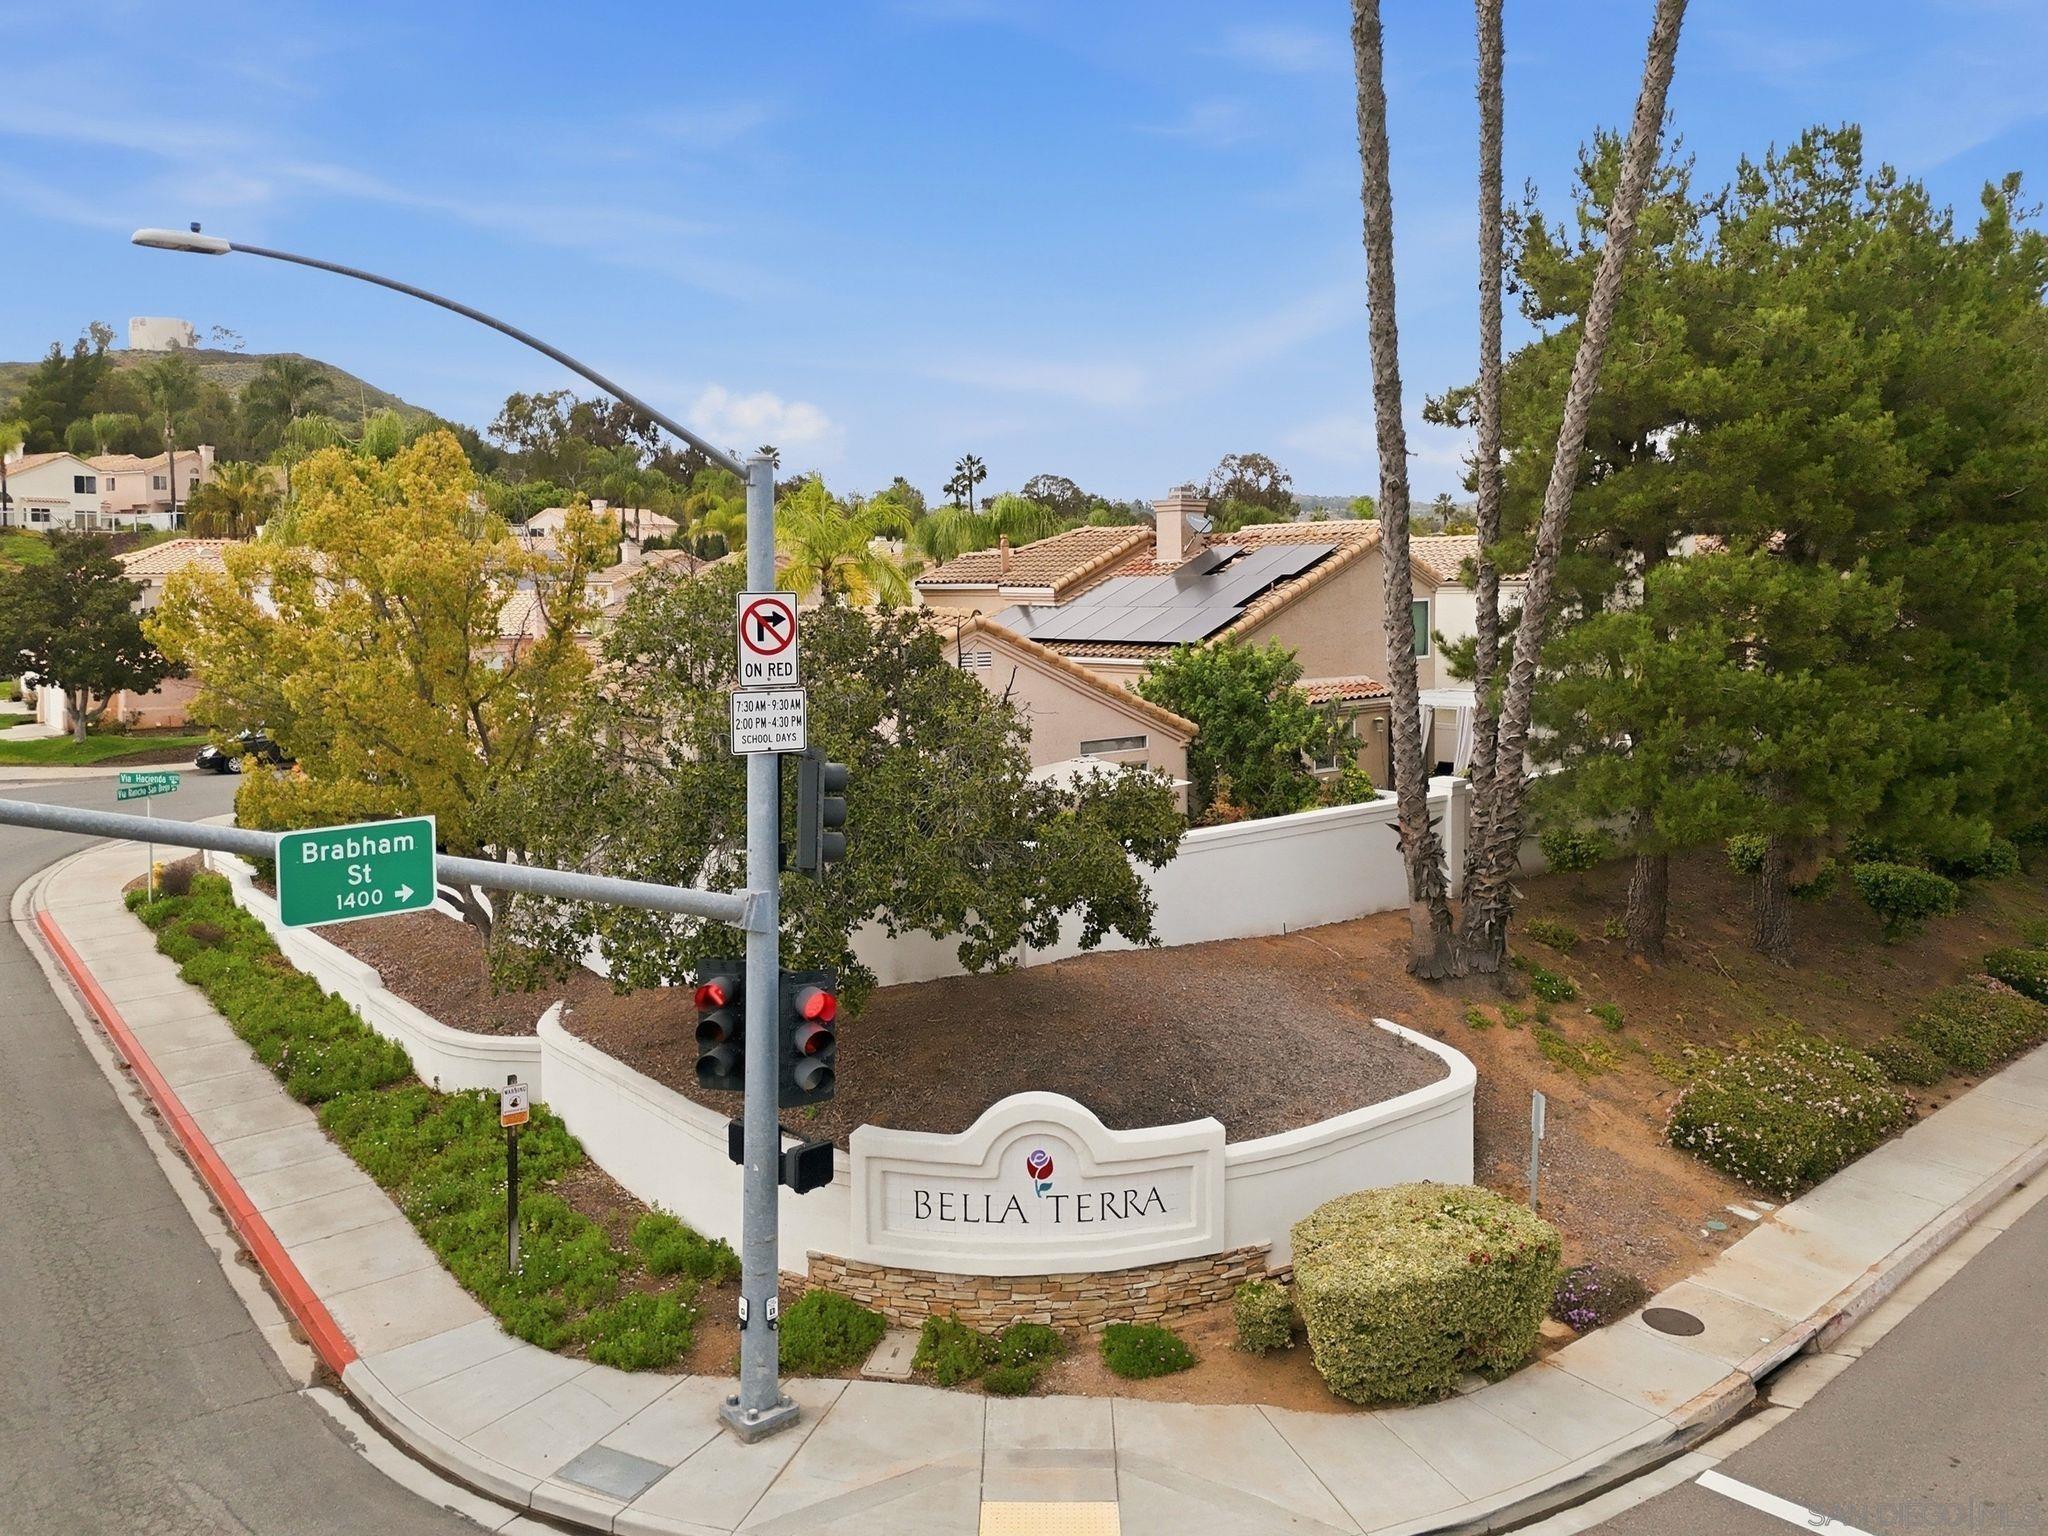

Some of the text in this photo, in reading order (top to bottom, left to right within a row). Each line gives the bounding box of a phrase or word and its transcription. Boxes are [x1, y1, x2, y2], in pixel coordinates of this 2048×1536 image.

[745, 662, 792, 677] ON RED
[736, 700, 754, 713] 7:30
[790, 698, 801, 711] AM
[735, 717, 753, 730] 2:00
[791, 715, 802, 727] PM
[741, 732, 797, 744] SCHOOL DAYS
[121, 774, 131, 782] Via
[136, 774, 166, 783] Hacienda
[302, 834, 414, 864] Brabham
[347, 863, 372, 886] St
[336, 888, 383, 911] 1400
[914, 1186, 1167, 1224] BELLA TERRA
